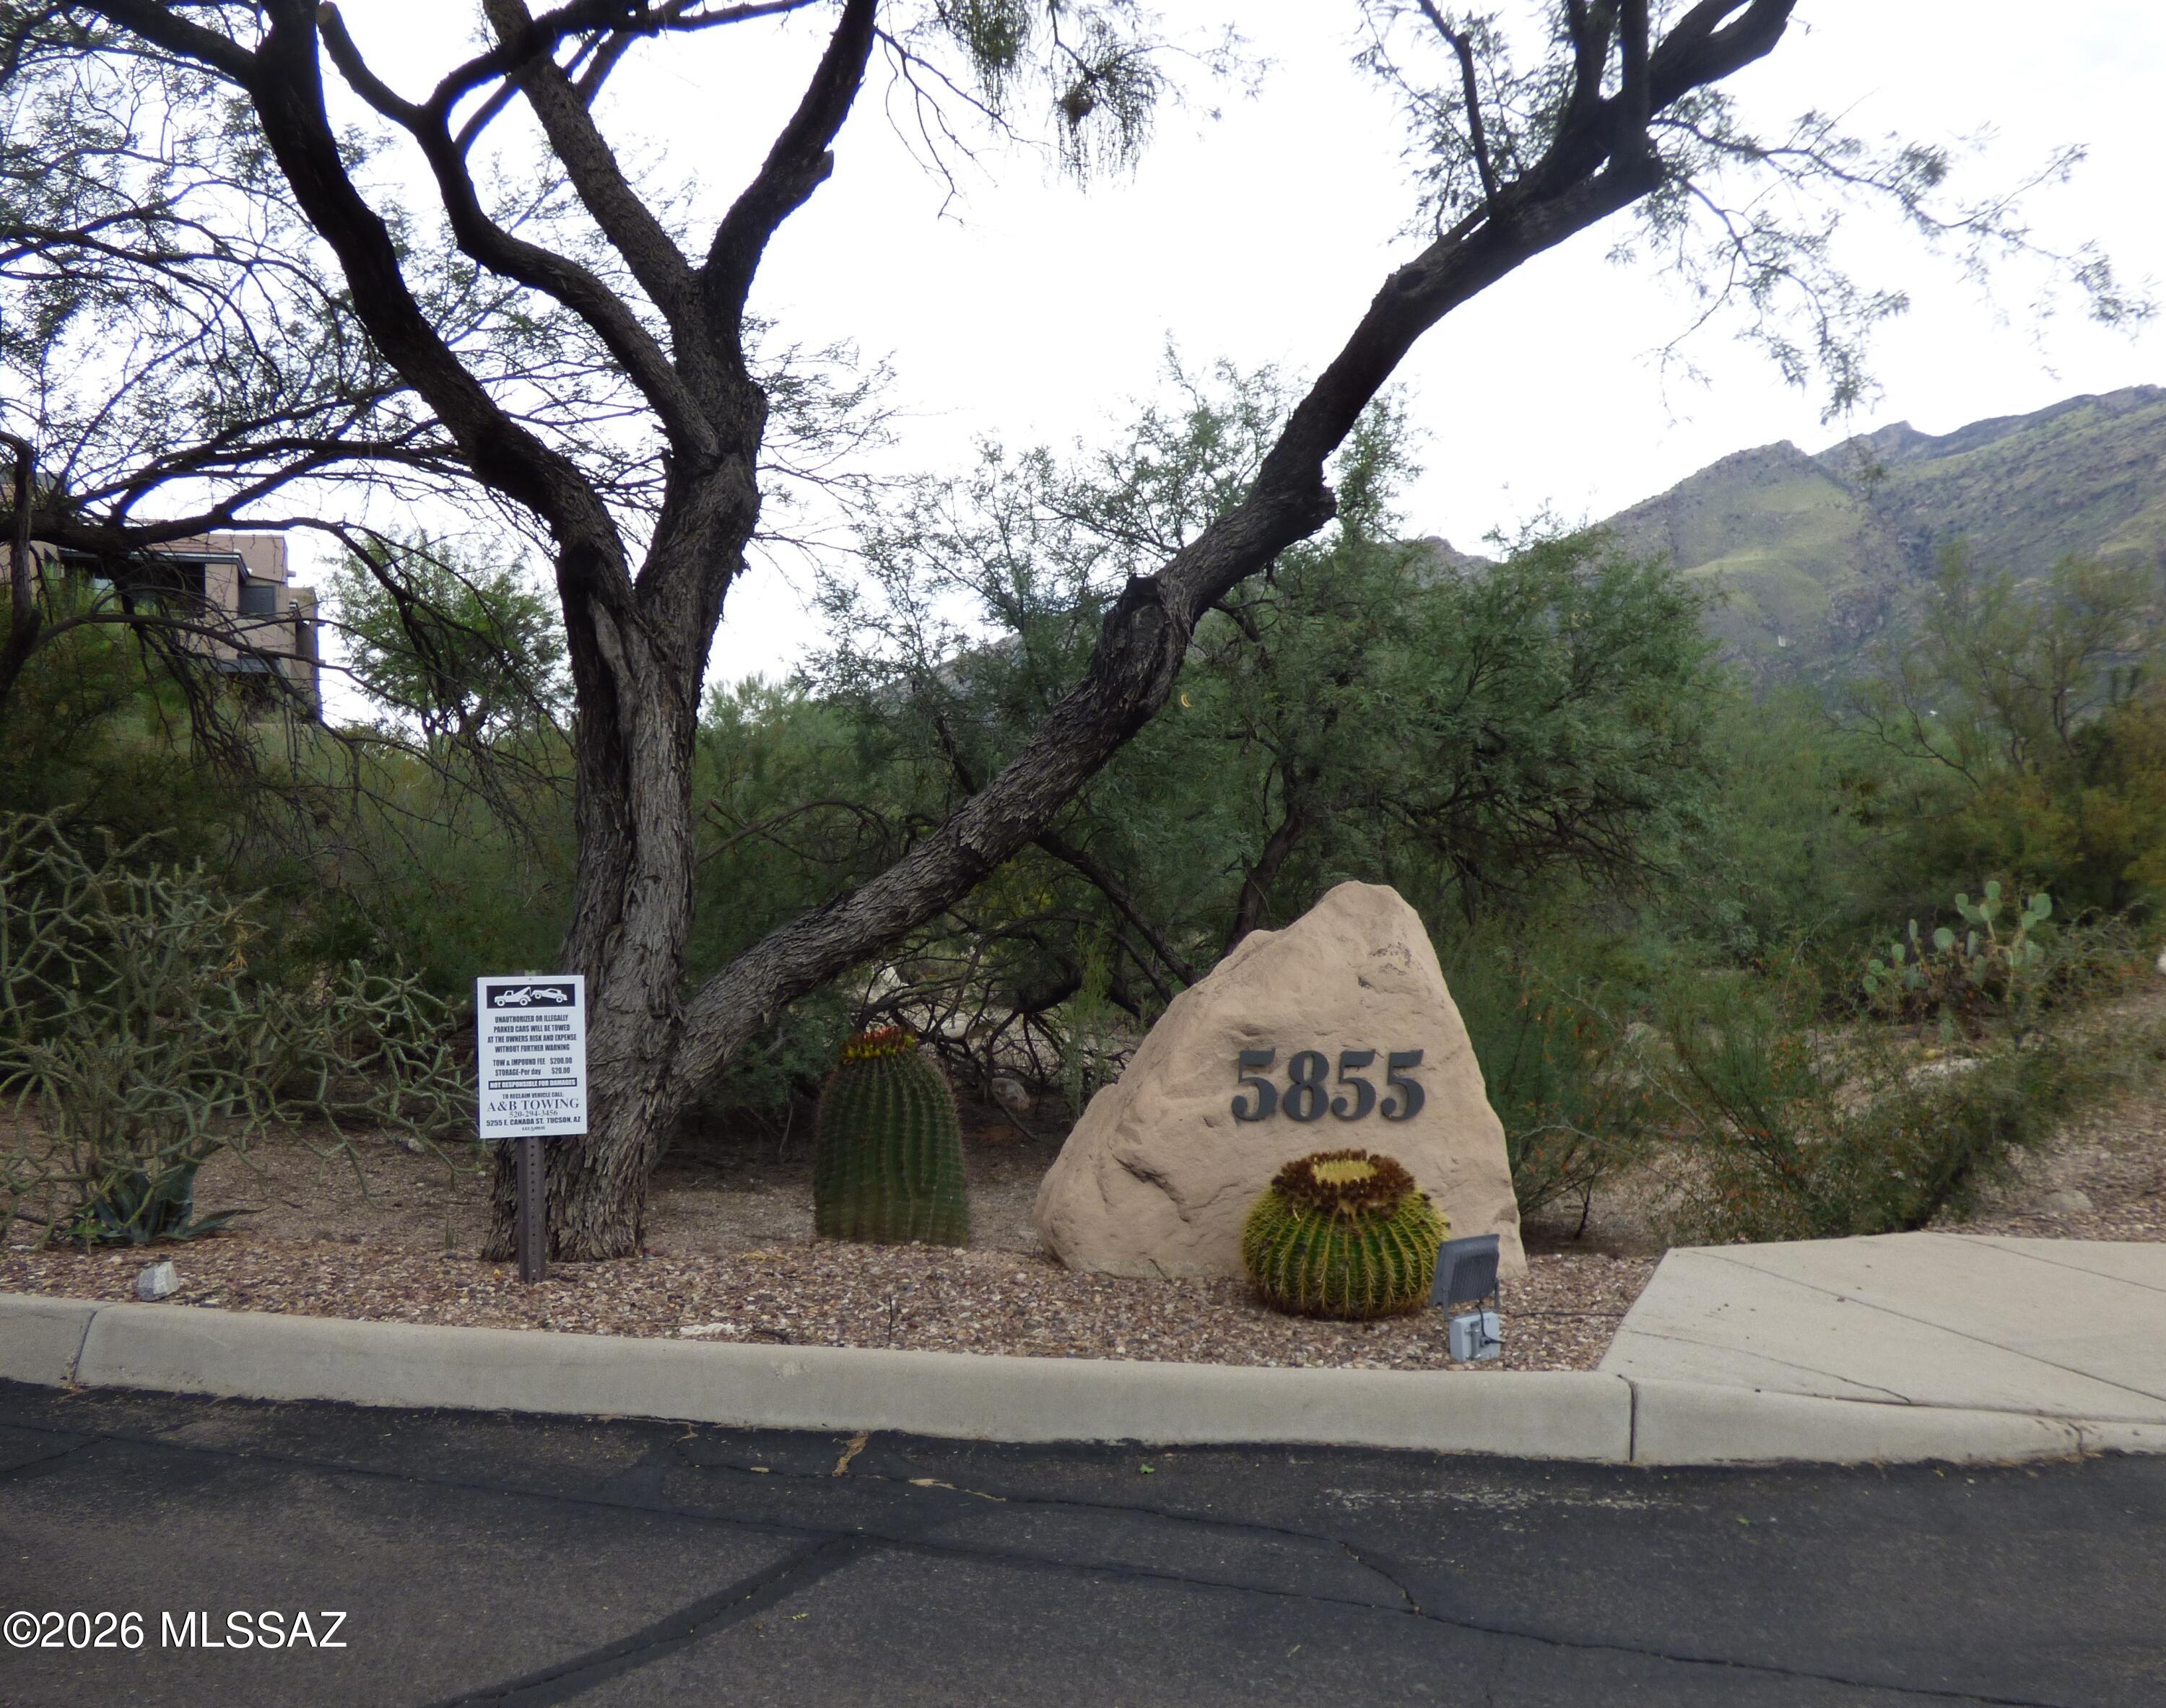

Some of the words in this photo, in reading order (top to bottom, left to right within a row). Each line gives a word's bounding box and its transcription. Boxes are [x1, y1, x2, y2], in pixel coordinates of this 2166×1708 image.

[487, 1101, 517, 1112] A&B
[521, 1099, 579, 1110] TOWING
[1232, 1049, 1425, 1121] 5855
